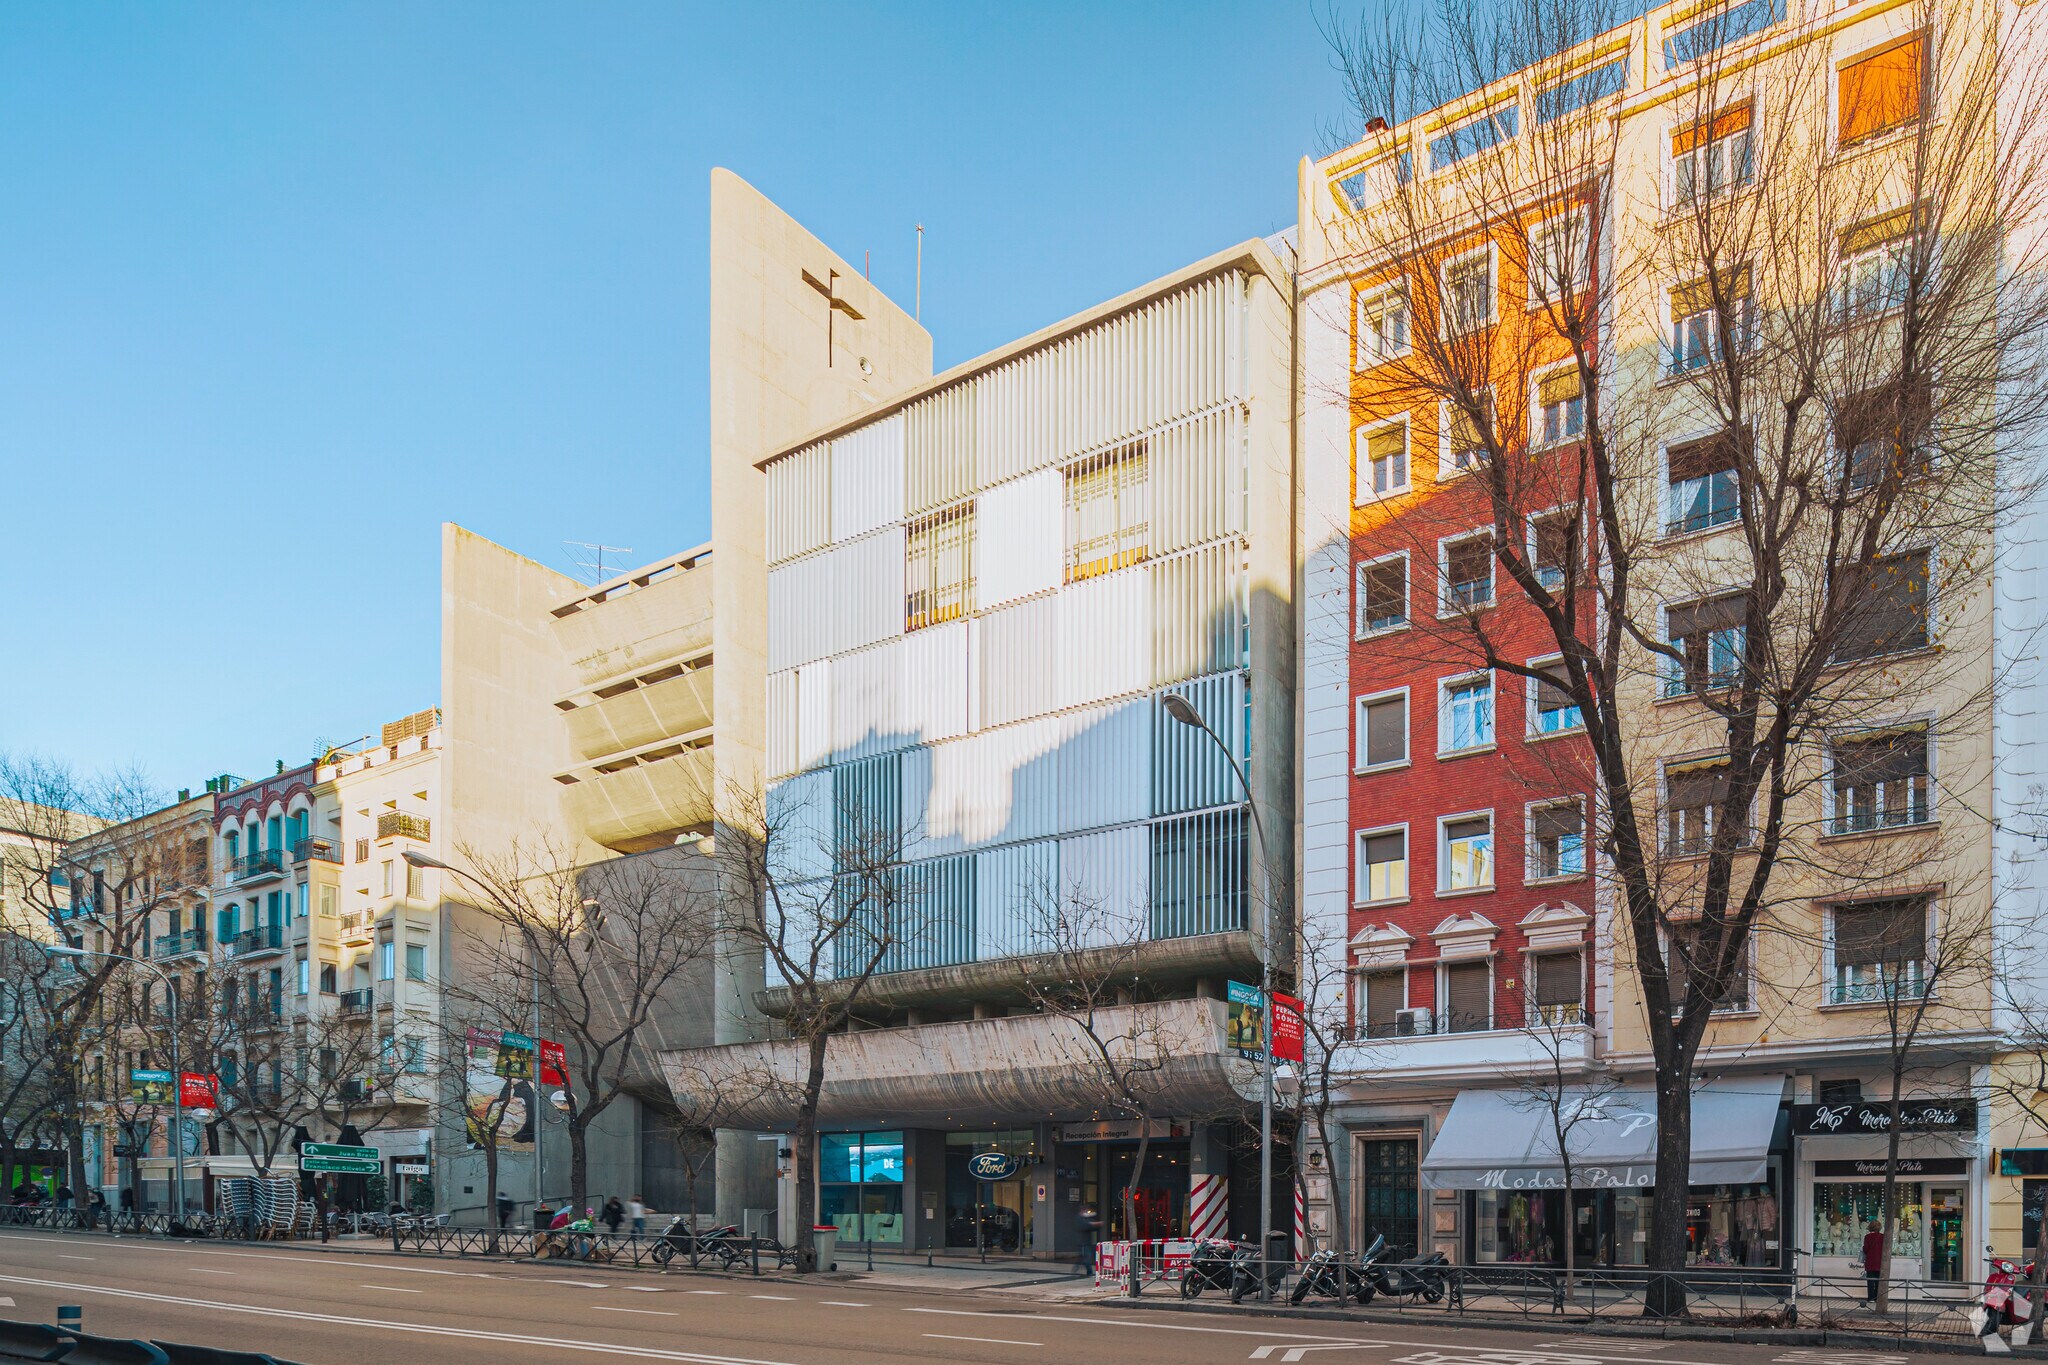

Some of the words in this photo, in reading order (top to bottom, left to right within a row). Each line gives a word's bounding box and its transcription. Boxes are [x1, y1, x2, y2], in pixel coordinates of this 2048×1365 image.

[1065, 1131, 1101, 1141] Recepción
[1102, 1129, 1129, 1140] Integral
[883, 1158, 895, 1169] DE
[977, 1156, 1006, 1174] Ford
